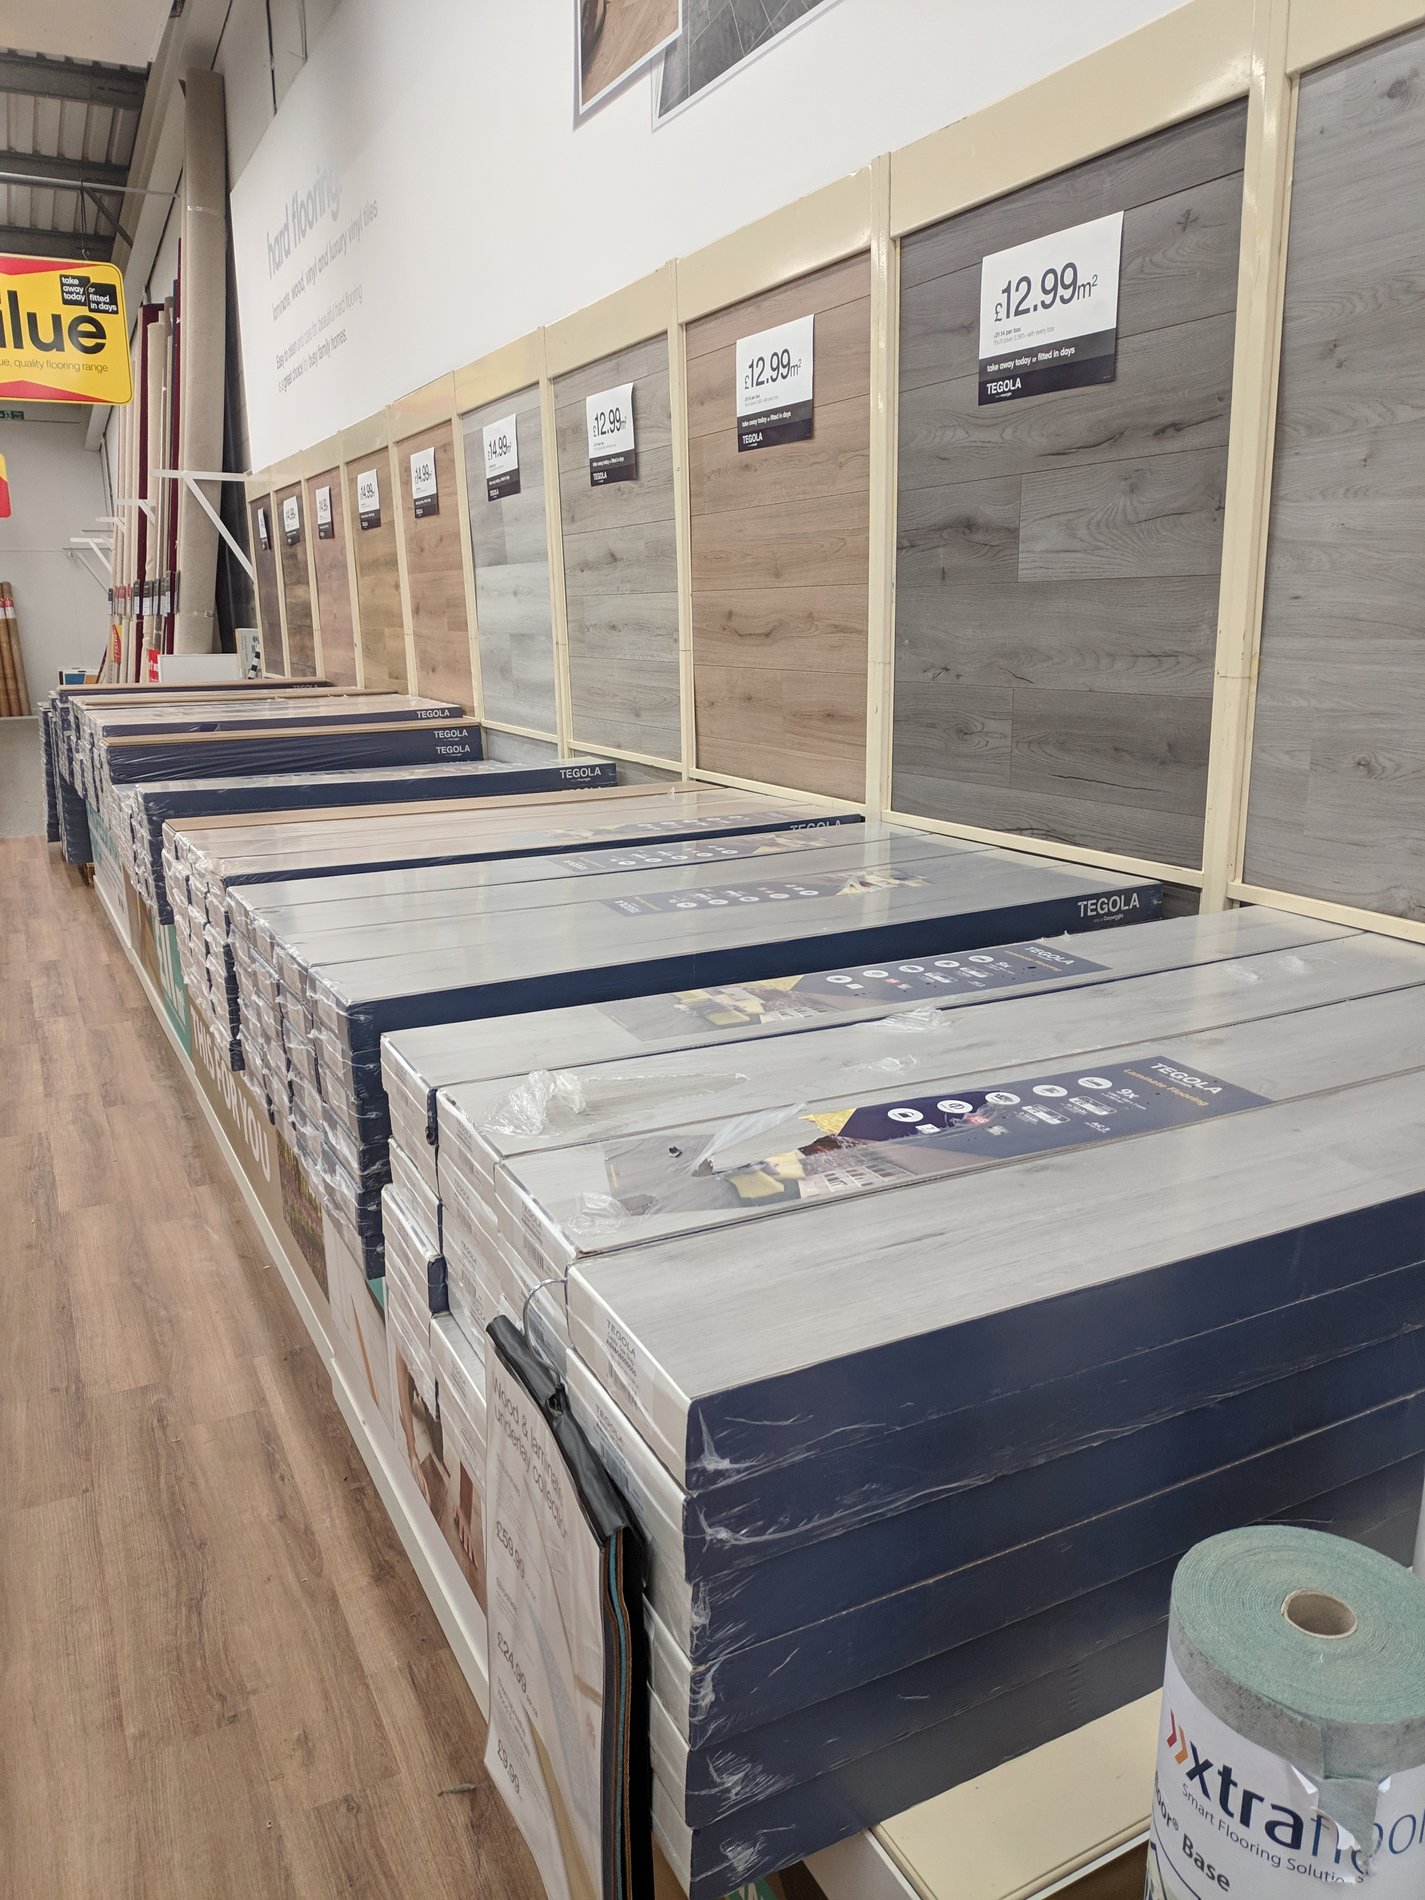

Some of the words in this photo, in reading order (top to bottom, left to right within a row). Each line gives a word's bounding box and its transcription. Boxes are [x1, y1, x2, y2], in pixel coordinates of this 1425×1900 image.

[266, 203, 291, 280] hard
[61, 276, 79, 285] take
[63, 286, 84, 294] away
[63, 293, 86, 303] today
[89, 294, 110, 303] fitted
[98, 302, 118, 312] days
[0, 289, 107, 354] lue
[1005, 329, 1013, 337] per
[15, 360, 44, 370] quality
[46, 360, 81, 372] flooring
[82, 363, 109, 374] range
[986, 363, 999, 372] take
[999, 360, 1015, 370] away
[1015, 355, 1032, 366] today
[1037, 350, 1052, 361] fitted
[1053, 349, 1059, 357] in
[1060, 346, 1076, 357] days
[986, 377, 1022, 395] TEGOLA
[742, 432, 763, 445] TEGOLA
[416, 709, 450, 719] TEGOLA
[433, 729, 469, 739] TEGOLA
[435, 744, 471, 755] TEGOLA
[560, 766, 602, 779] TEGOLA
[1077, 892, 1140, 918] TEGOLA
[1024, 946, 1075, 965] TEGOLA
[1150, 1062, 1223, 1095] TEGOLA
[214, 1047, 241, 1130] FOR
[236, 1086, 271, 1183] YOU
[606, 1319, 637, 1358] TEGOLA
[493, 1374, 519, 1425] Wood
[521, 1414, 529, 1438] &
[494, 1403, 531, 1473] underlay
[496, 1520, 525, 1580] £59.99
[497, 1631, 527, 1694] £24.99
[497, 1738, 520, 1794] £9.99
[1182, 1782, 1216, 1826] Smart
[1218, 1818, 1282, 1869] Flooring
[1286, 1858, 1365, 1884] Solutis
[1182, 1832, 1231, 1893] Base
